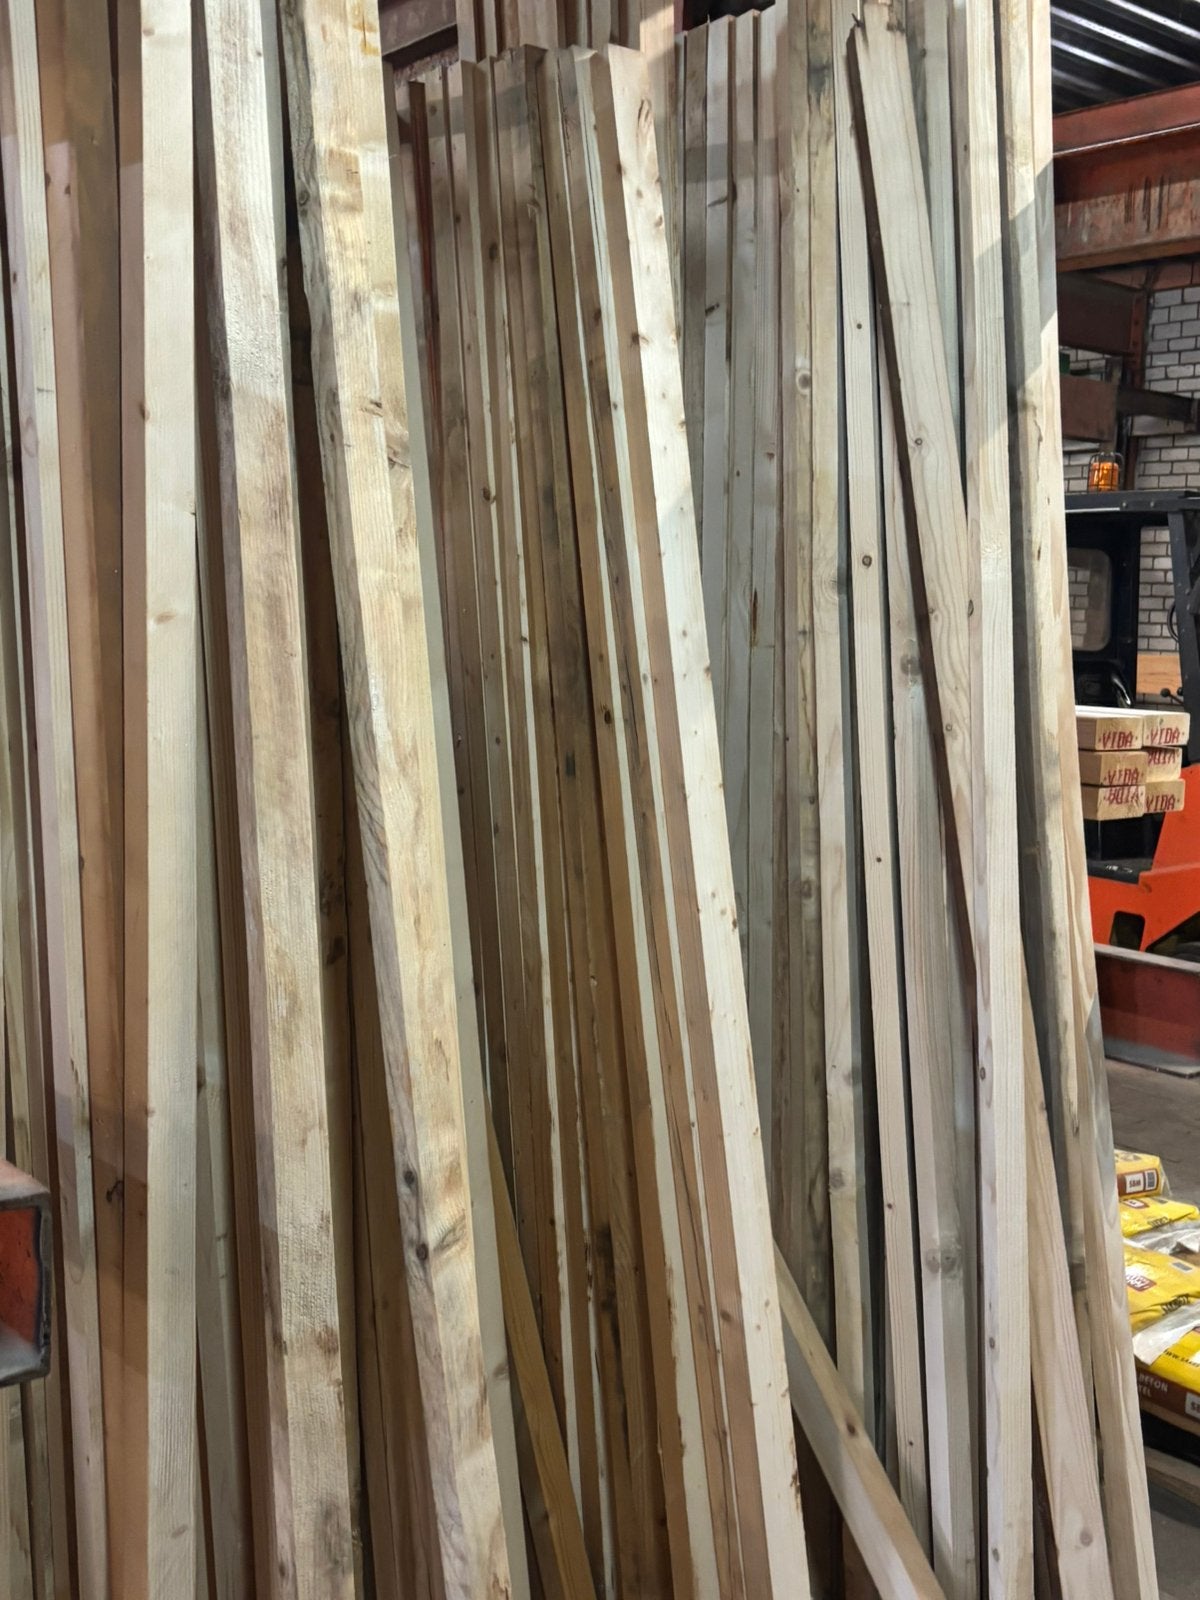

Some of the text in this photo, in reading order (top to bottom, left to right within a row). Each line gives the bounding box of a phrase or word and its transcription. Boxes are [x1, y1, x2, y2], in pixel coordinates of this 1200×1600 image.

[1102, 732, 1133, 749] VIDA
[1151, 727, 1180, 745] VIDA
[1109, 768, 1139, 784] VIDA
[1145, 795, 1176, 811] VIDA
